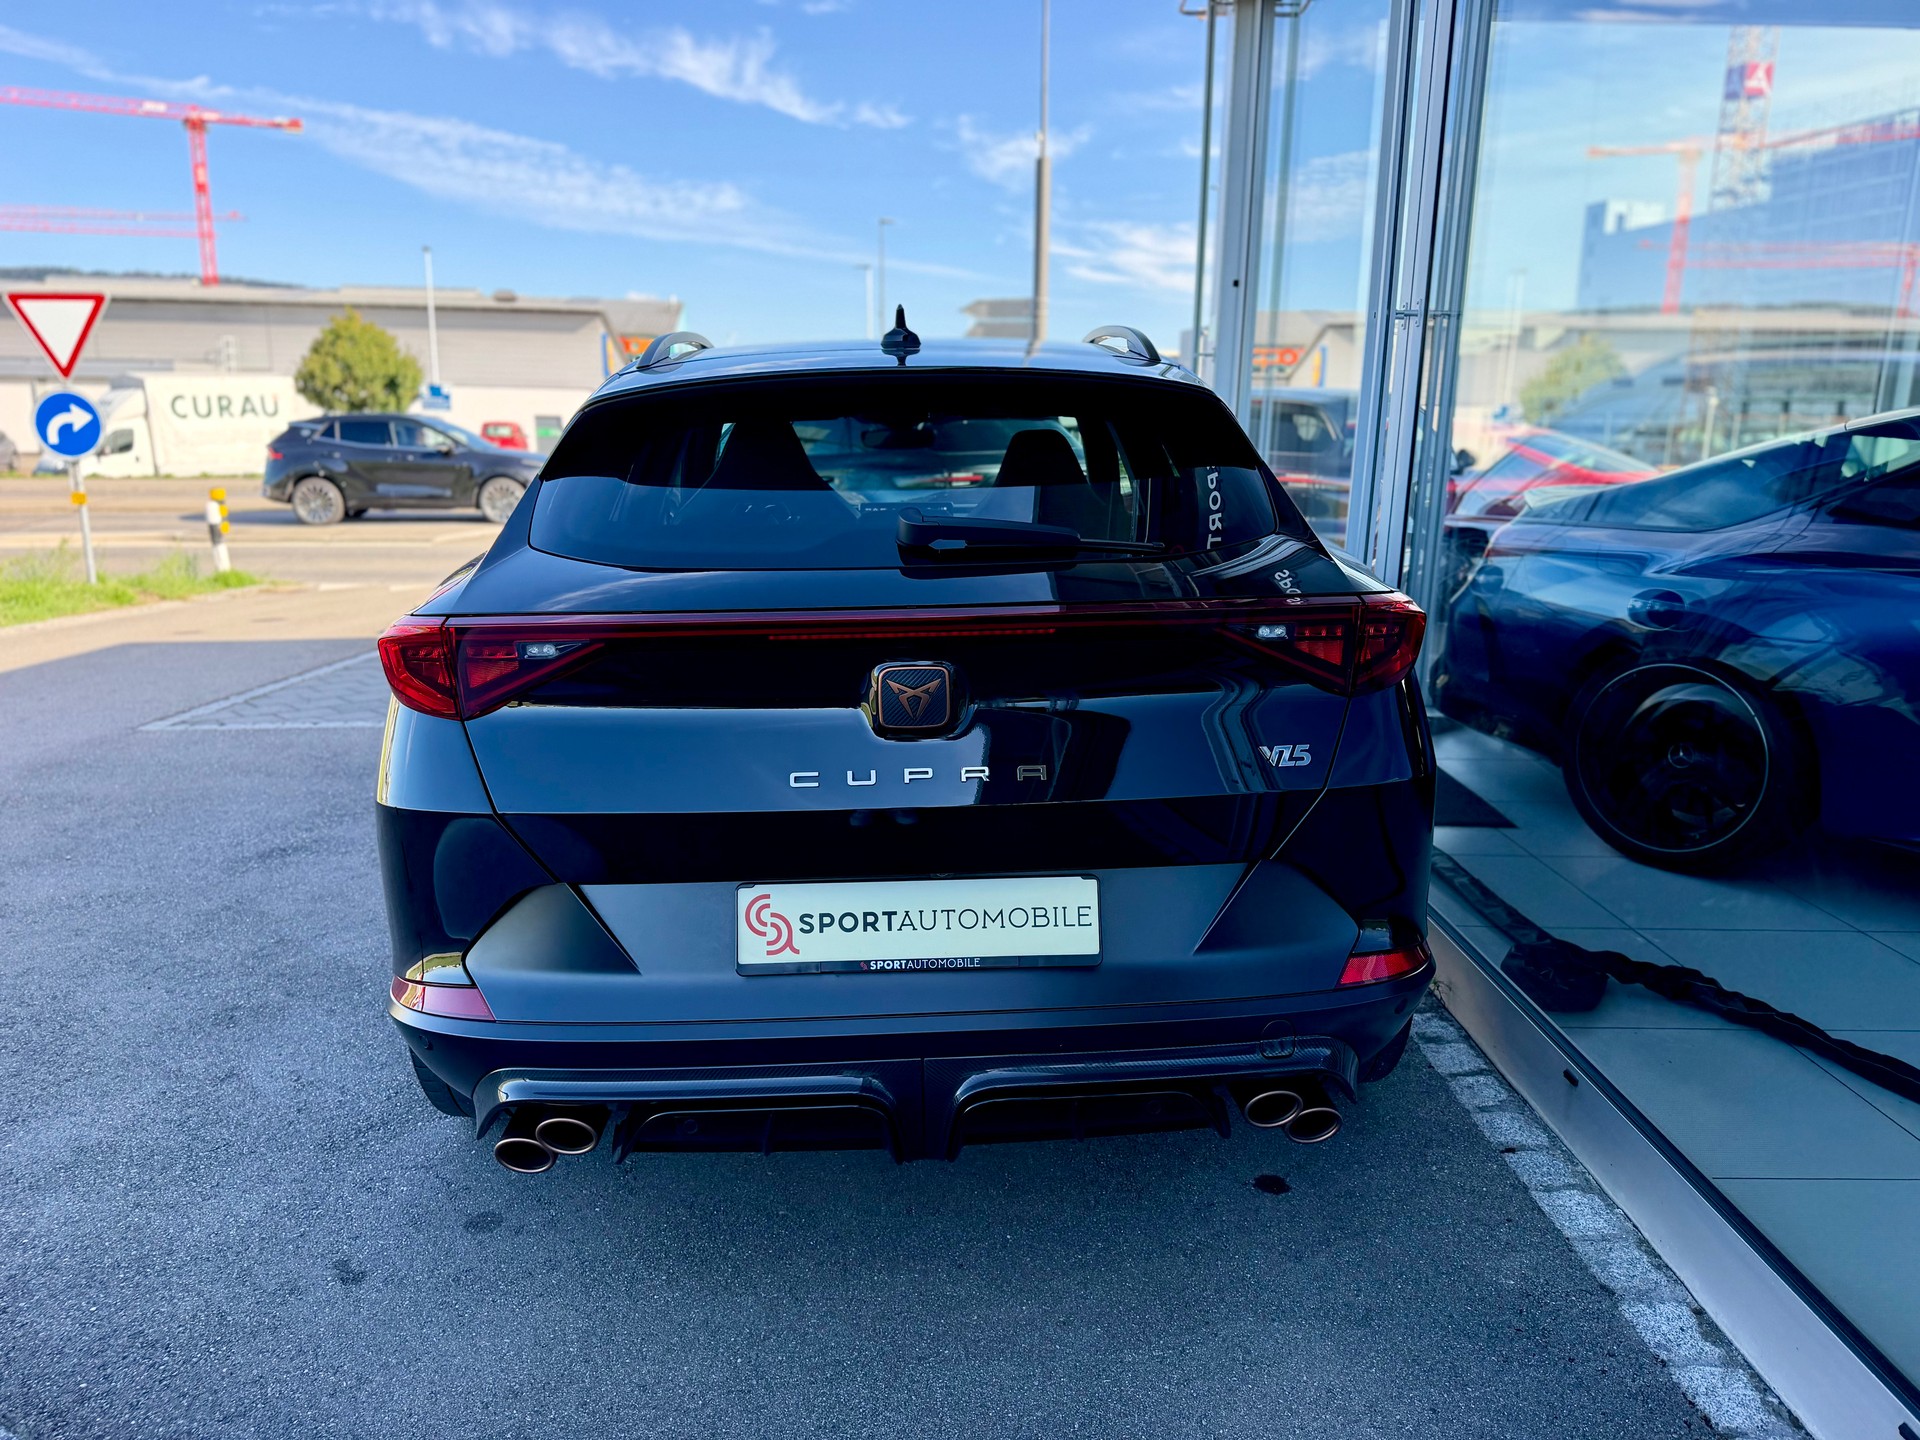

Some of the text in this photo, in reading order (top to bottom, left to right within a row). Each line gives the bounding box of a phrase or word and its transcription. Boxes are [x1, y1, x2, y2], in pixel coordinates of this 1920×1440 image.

[171, 394, 279, 419] CURAU
[1258, 744, 1312, 767] VZ5
[789, 765, 1048, 788] CUPRA
[799, 905, 1093, 935] SPORTAUTOMOBILE
[870, 957, 981, 971] SPORTAUTOMOBILE
